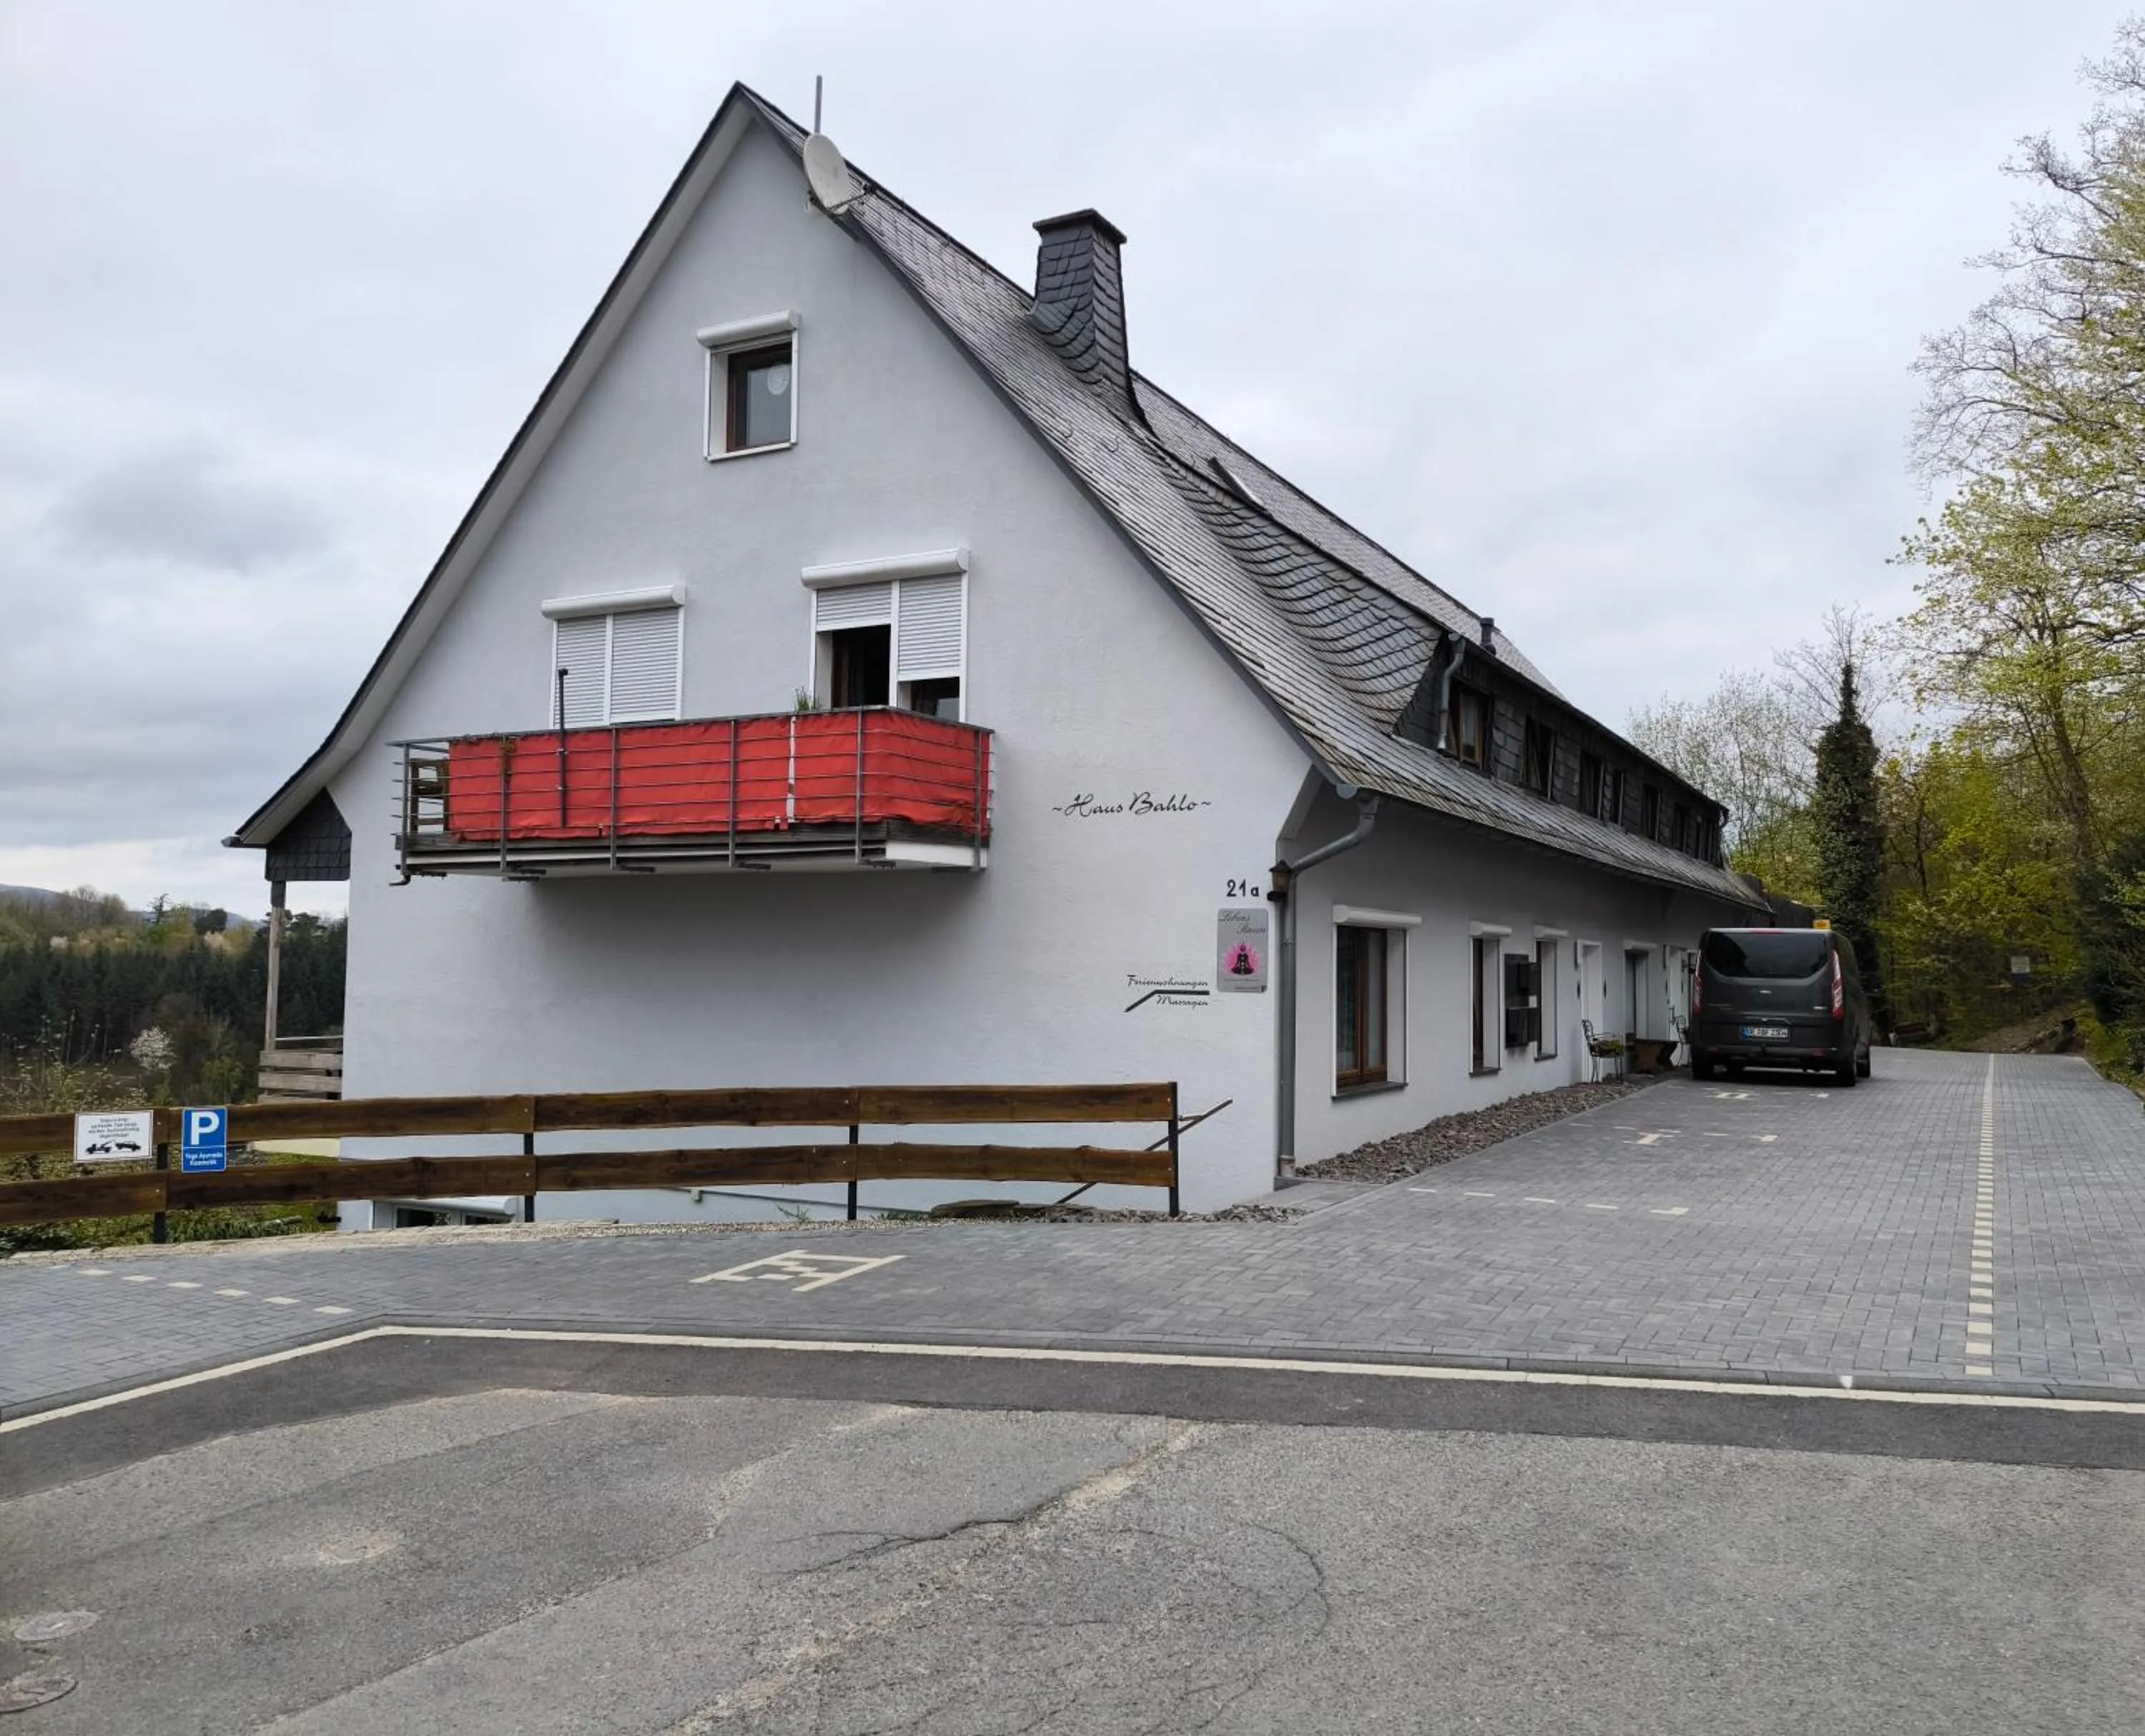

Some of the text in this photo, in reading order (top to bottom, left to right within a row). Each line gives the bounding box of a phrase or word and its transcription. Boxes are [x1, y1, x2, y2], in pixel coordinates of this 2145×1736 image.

[1226, 879, 1259, 897] 21a
[1127, 974, 1208, 990] Ferienwohnungen
[190, 1111, 220, 1145] P
